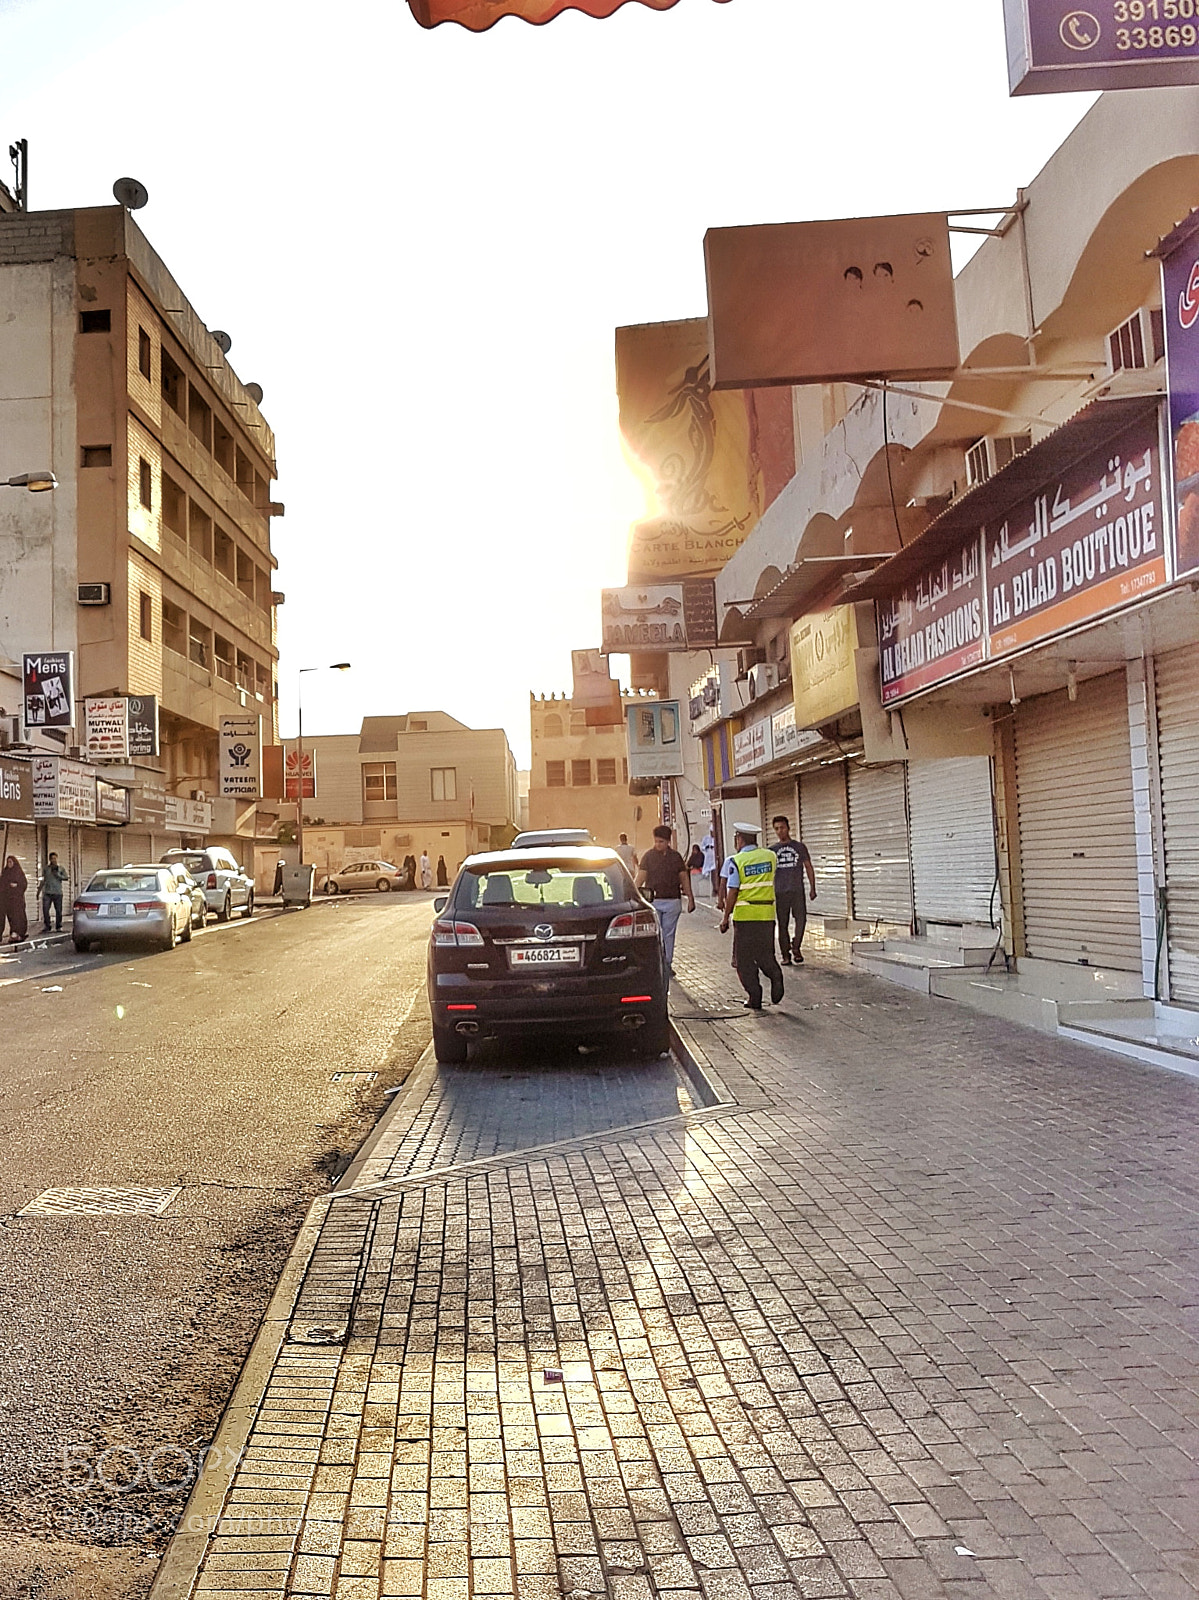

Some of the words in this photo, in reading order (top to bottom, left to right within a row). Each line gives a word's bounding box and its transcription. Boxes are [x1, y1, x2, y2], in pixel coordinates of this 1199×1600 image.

[1114, 0, 1199, 22] 39150
[1116, 24, 1199, 50] 33869
[1051, 448, 1152, 533] بوتيك
[991, 494, 1048, 568] البلاد
[632, 542, 680, 552] CARTE
[685, 538, 745, 550] BLANCH
[993, 583, 1010, 627] AL
[1012, 557, 1057, 616] BILAD
[1061, 501, 1156, 593] BOUTIQUE
[883, 648, 895, 682] AL
[895, 630, 925, 677] BELAD
[925, 598, 982, 662] FASHIONS
[27, 658, 66, 674] Mens
[524, 949, 561, 962] 466821
